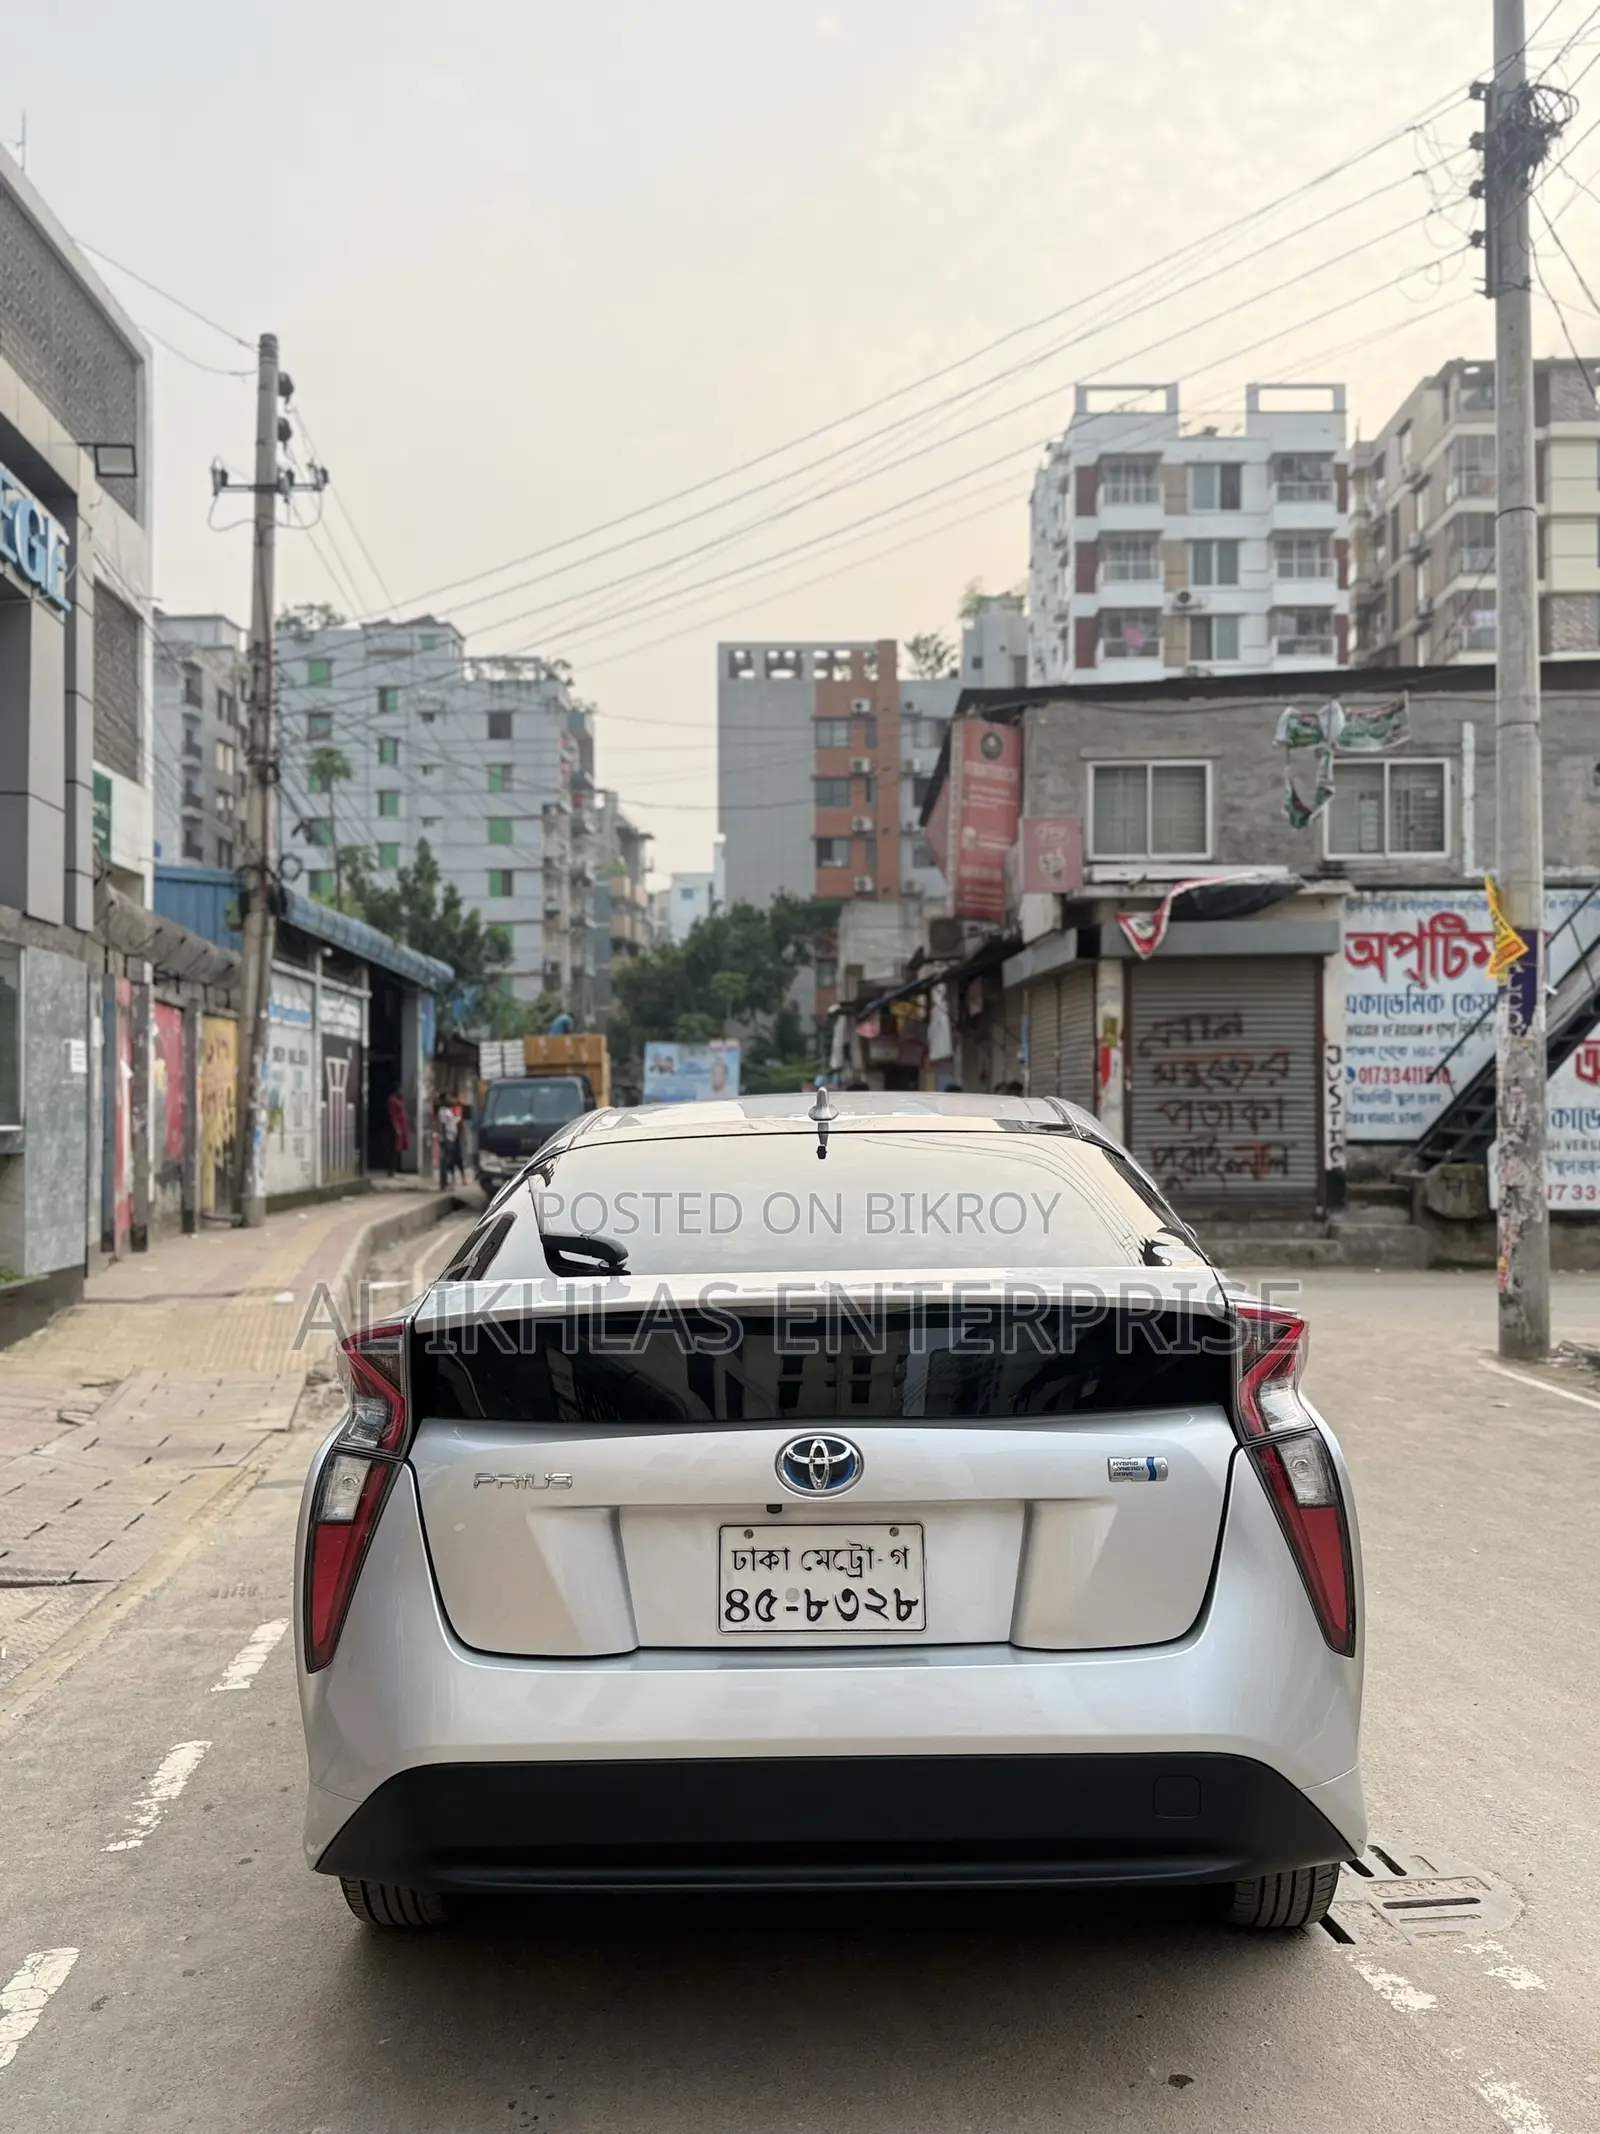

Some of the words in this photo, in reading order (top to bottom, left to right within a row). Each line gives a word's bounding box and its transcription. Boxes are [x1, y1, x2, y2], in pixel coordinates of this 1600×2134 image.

[1326, 1043, 1343, 1163] JUSTIC
[473, 1472, 573, 1490] PRIUS
[731, 1547, 790, 1571] ঢাকা
[724, 1587, 919, 1623] ৪৫-৮৩২৮
